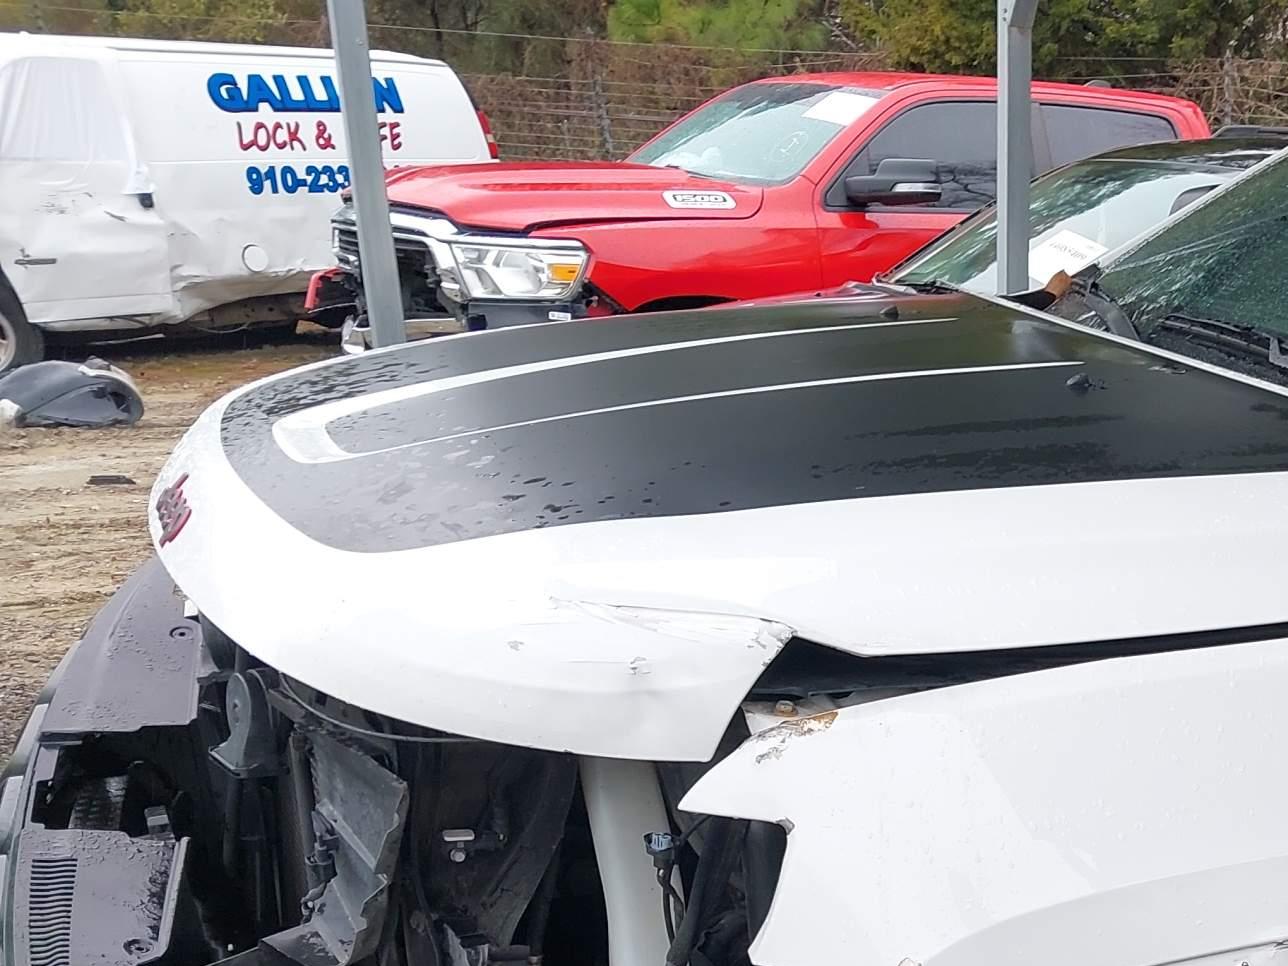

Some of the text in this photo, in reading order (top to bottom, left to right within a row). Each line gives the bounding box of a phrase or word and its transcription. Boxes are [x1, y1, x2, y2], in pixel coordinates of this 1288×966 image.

[207, 72, 405, 113] GALLIN
[237, 120, 402, 151] LOCK & FE
[246, 165, 350, 195] 910-233
[672, 194, 727, 202] 1500
